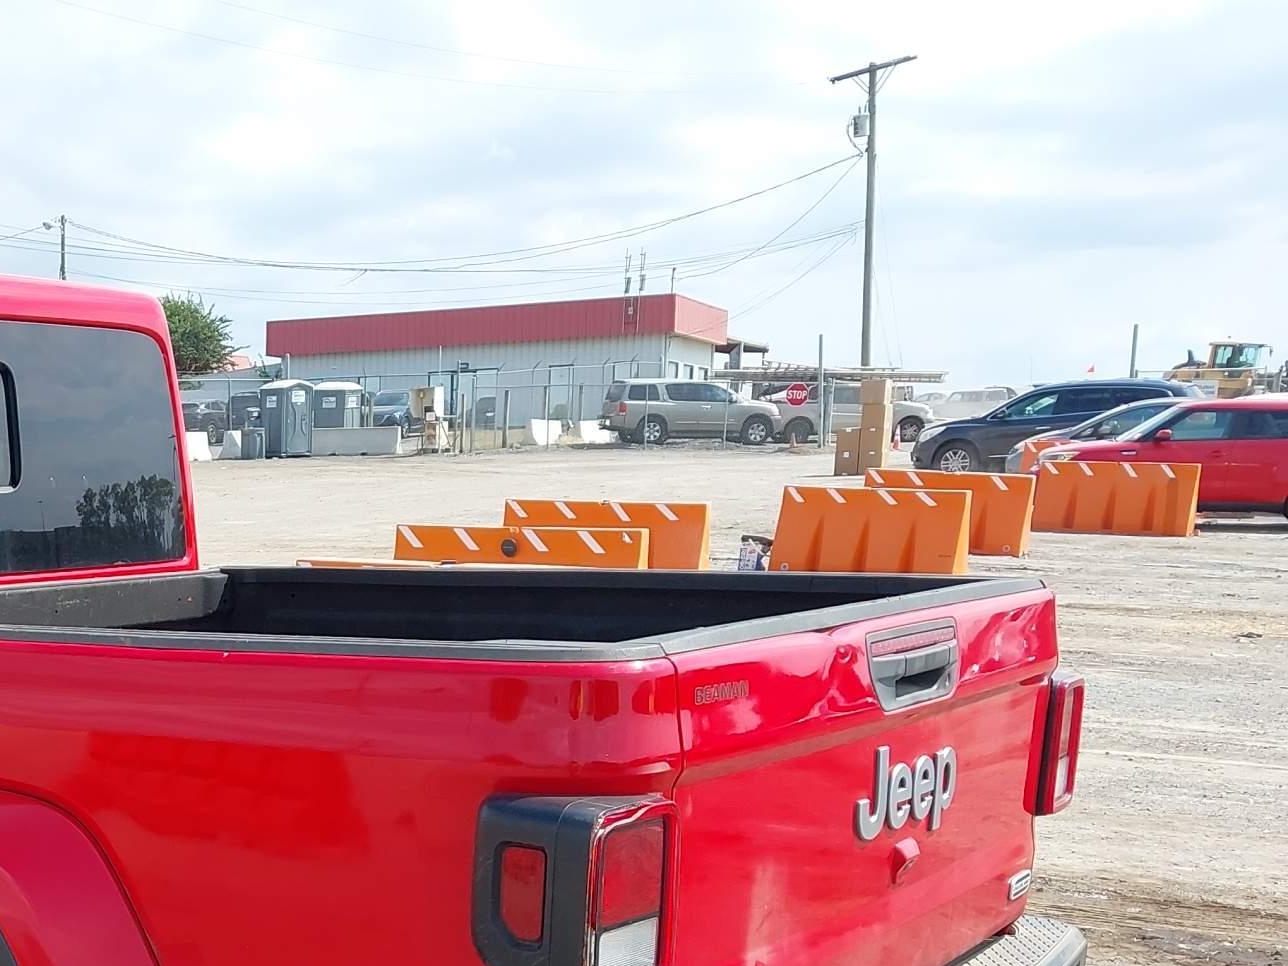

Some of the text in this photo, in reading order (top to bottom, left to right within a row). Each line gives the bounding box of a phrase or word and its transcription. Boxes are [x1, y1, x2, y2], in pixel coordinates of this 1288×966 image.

[787, 390, 808, 400] STOP
[694, 680, 750, 705] BEAMAN
[856, 745, 957, 841] Jeep
